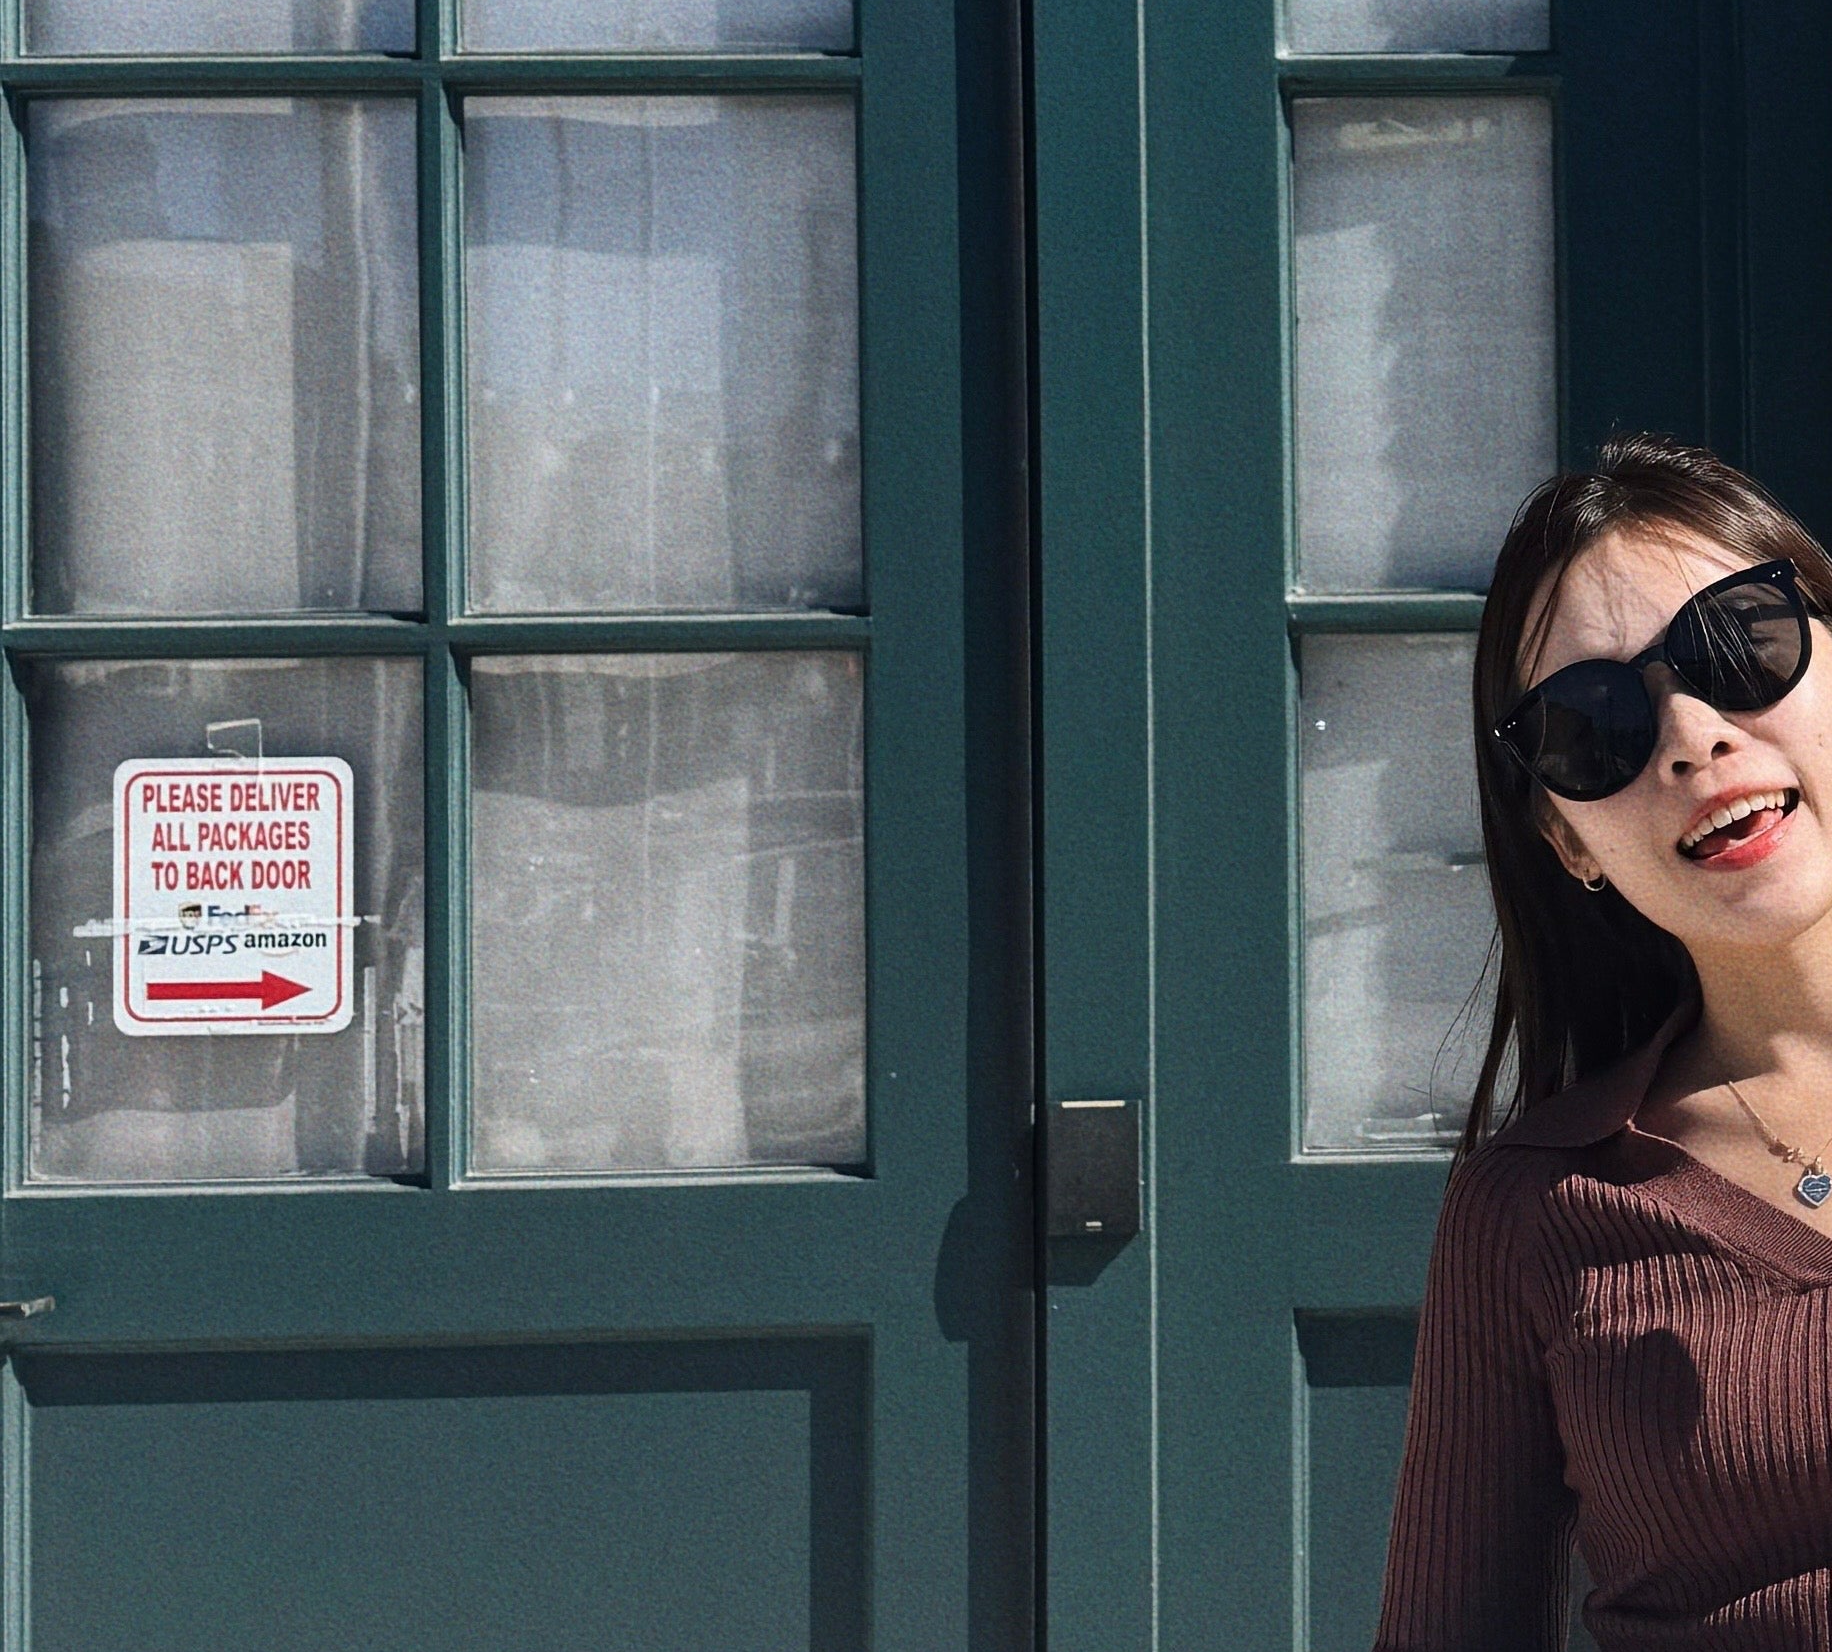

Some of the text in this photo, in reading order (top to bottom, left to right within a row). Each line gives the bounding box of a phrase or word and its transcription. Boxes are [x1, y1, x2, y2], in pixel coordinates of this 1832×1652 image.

[142, 782, 320, 813] PLEASE DELIVER
[152, 821, 311, 852] ALL PACKAGES
[151, 860, 311, 891] TO BACK DOOR
[171, 934, 239, 955] USPS
[244, 932, 327, 949] amazon
